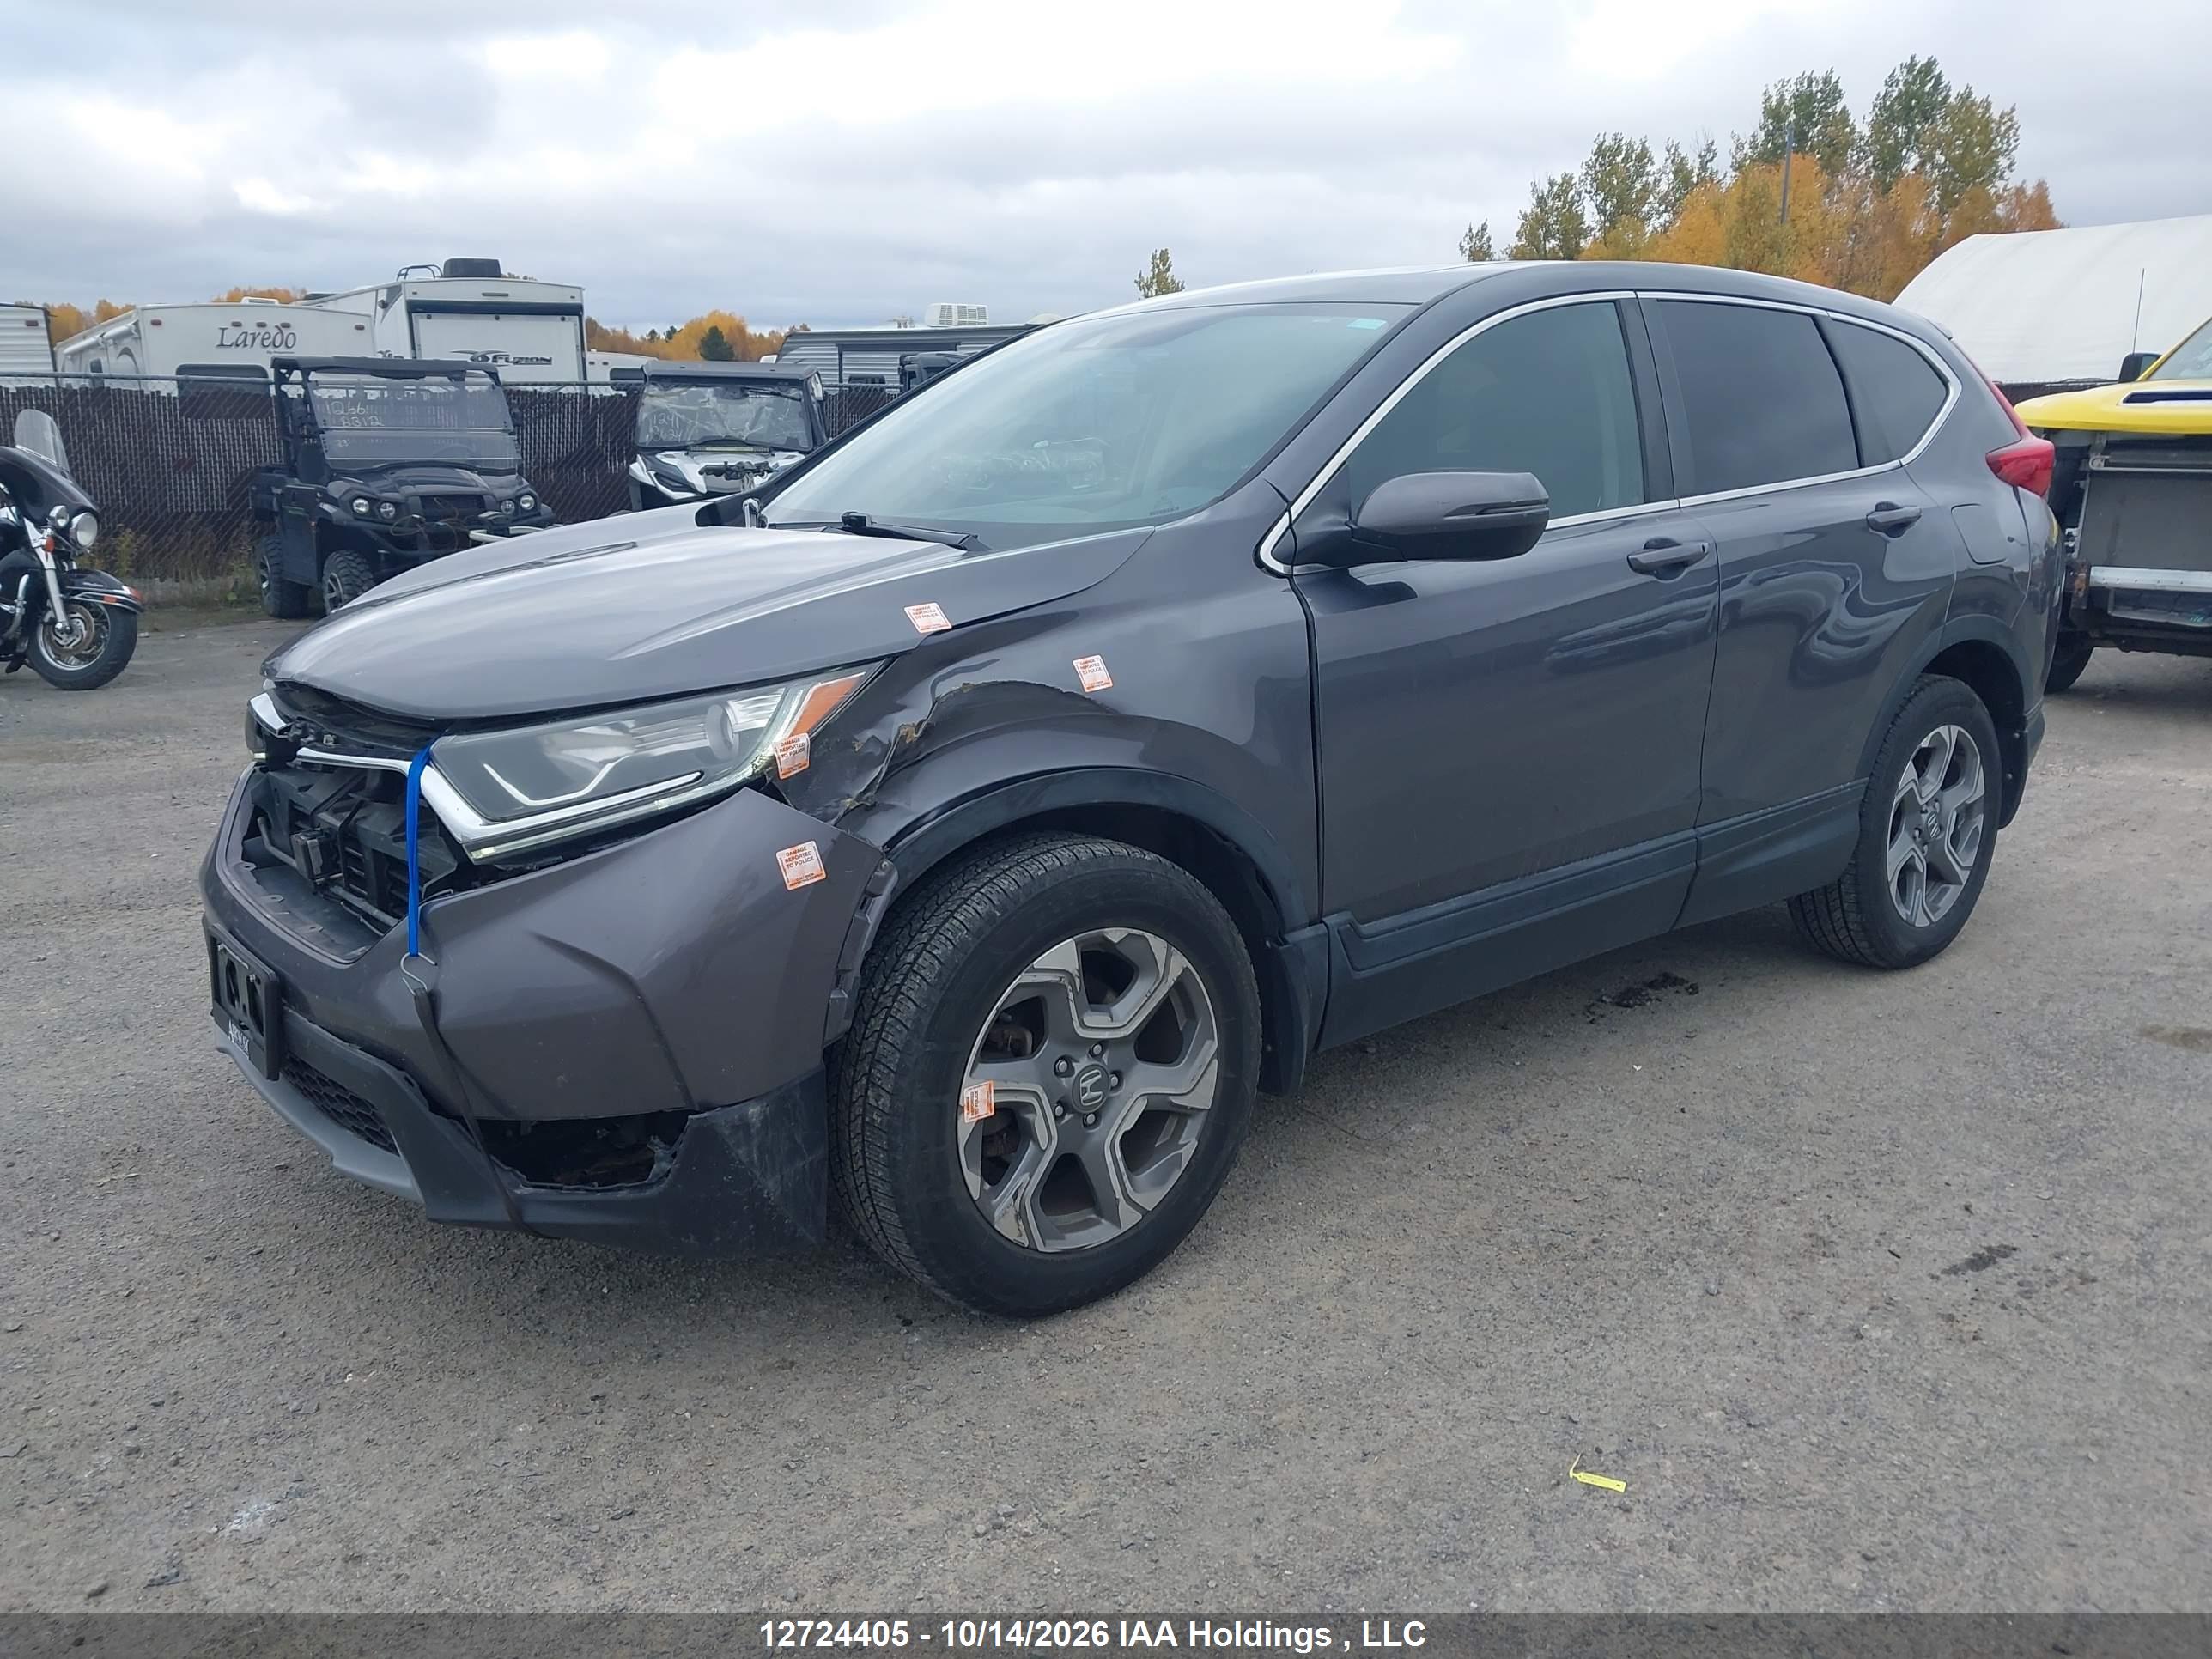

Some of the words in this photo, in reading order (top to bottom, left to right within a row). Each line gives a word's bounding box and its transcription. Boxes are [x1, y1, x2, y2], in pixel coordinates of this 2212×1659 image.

[216, 325, 297, 349] Laredo
[326, 401, 366, 416] 1266
[785, 850, 812, 864] REPORTED
[786, 846, 807, 857] DAMAGE
[795, 856, 815, 867] POLICE
